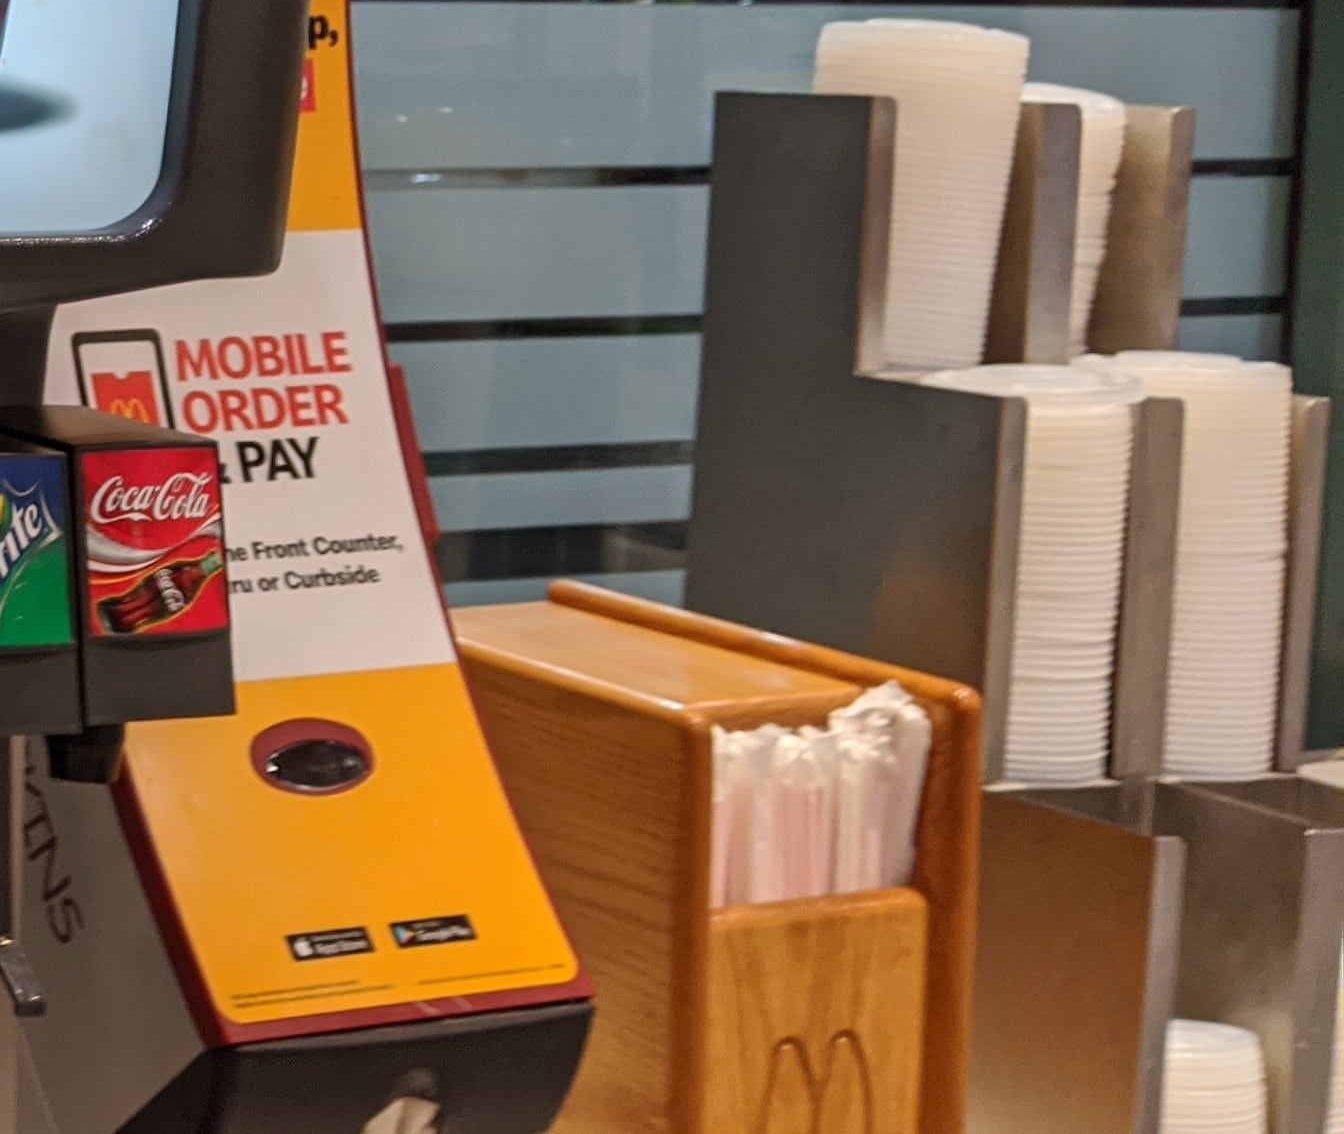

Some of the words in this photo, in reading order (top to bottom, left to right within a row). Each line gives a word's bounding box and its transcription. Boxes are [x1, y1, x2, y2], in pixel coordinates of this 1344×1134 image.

[175, 332, 353, 382] MOBILE
[182, 383, 350, 435] ORDER
[236, 436, 320, 484] PAY
[90, 471, 214, 524] Coca-Cola
[252, 538, 311, 560] Front
[313, 533, 404, 559] Counter,
[258, 575, 279, 593] or
[284, 564, 380, 590] Curbside
